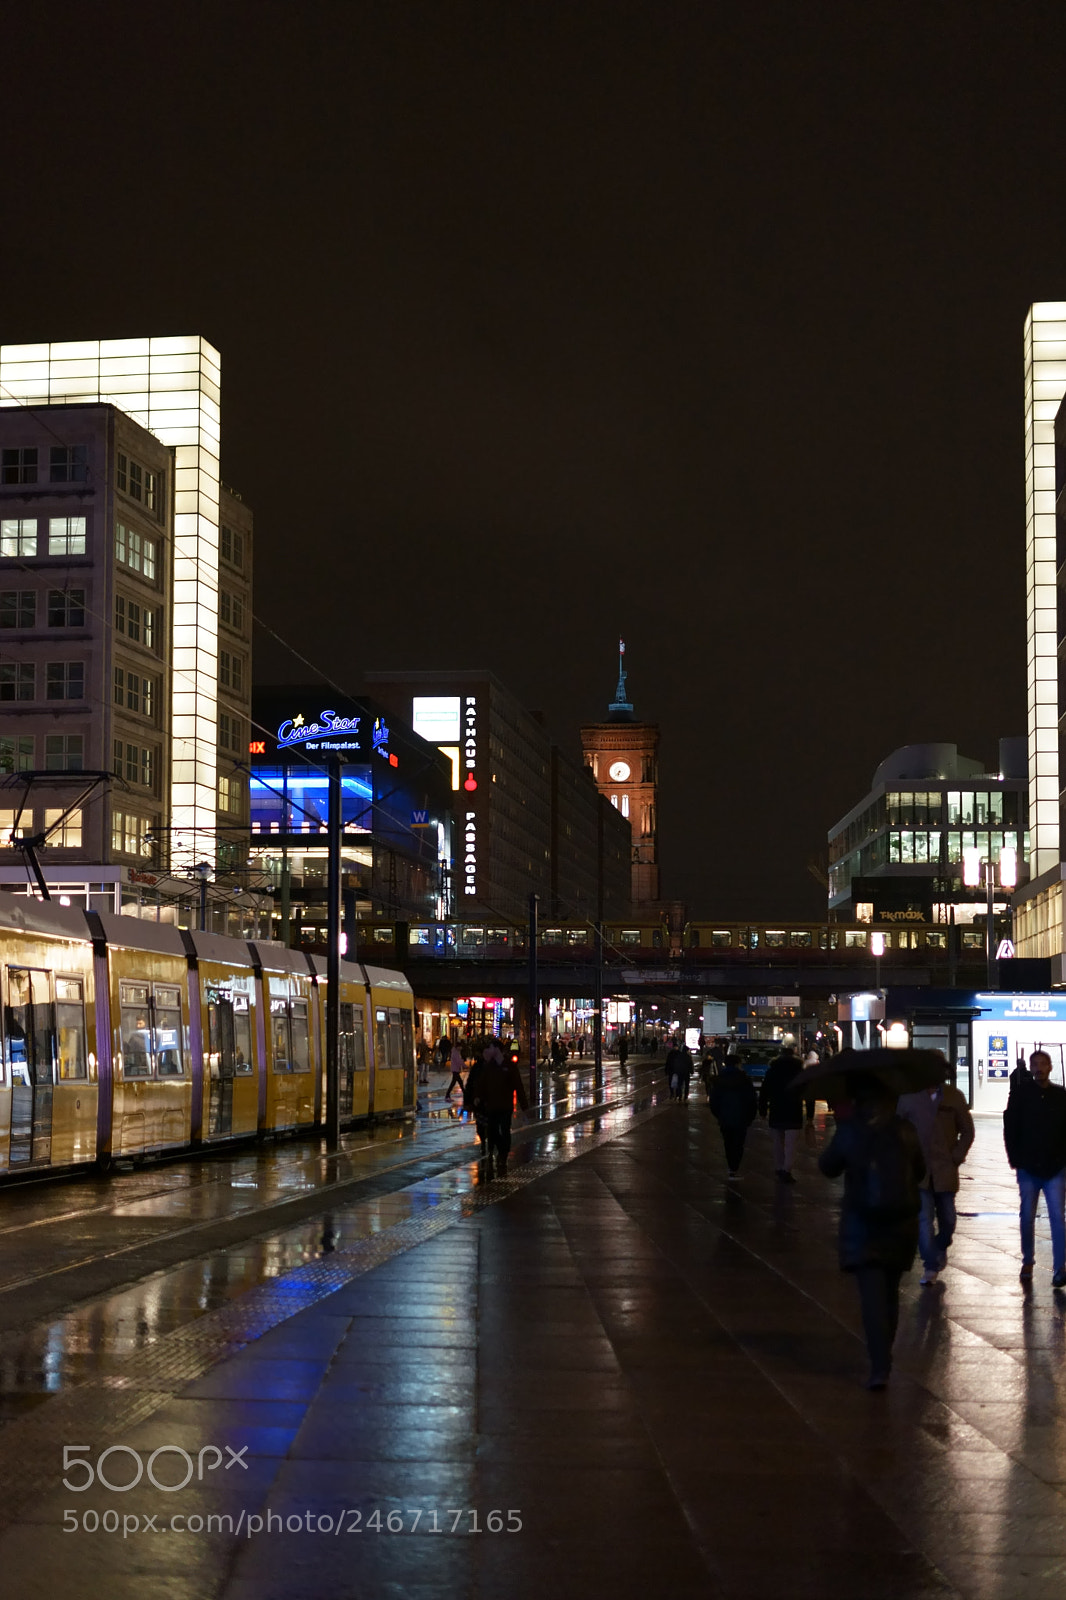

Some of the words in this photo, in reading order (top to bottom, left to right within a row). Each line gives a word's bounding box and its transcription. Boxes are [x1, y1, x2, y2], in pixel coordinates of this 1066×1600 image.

[465, 697, 476, 768] RATHAUS
[306, 742, 318, 750] Der
[413, 811, 426, 823] W
[464, 812, 476, 895] PASSAGEN
[1012, 999, 1049, 1011] POLIZEI
